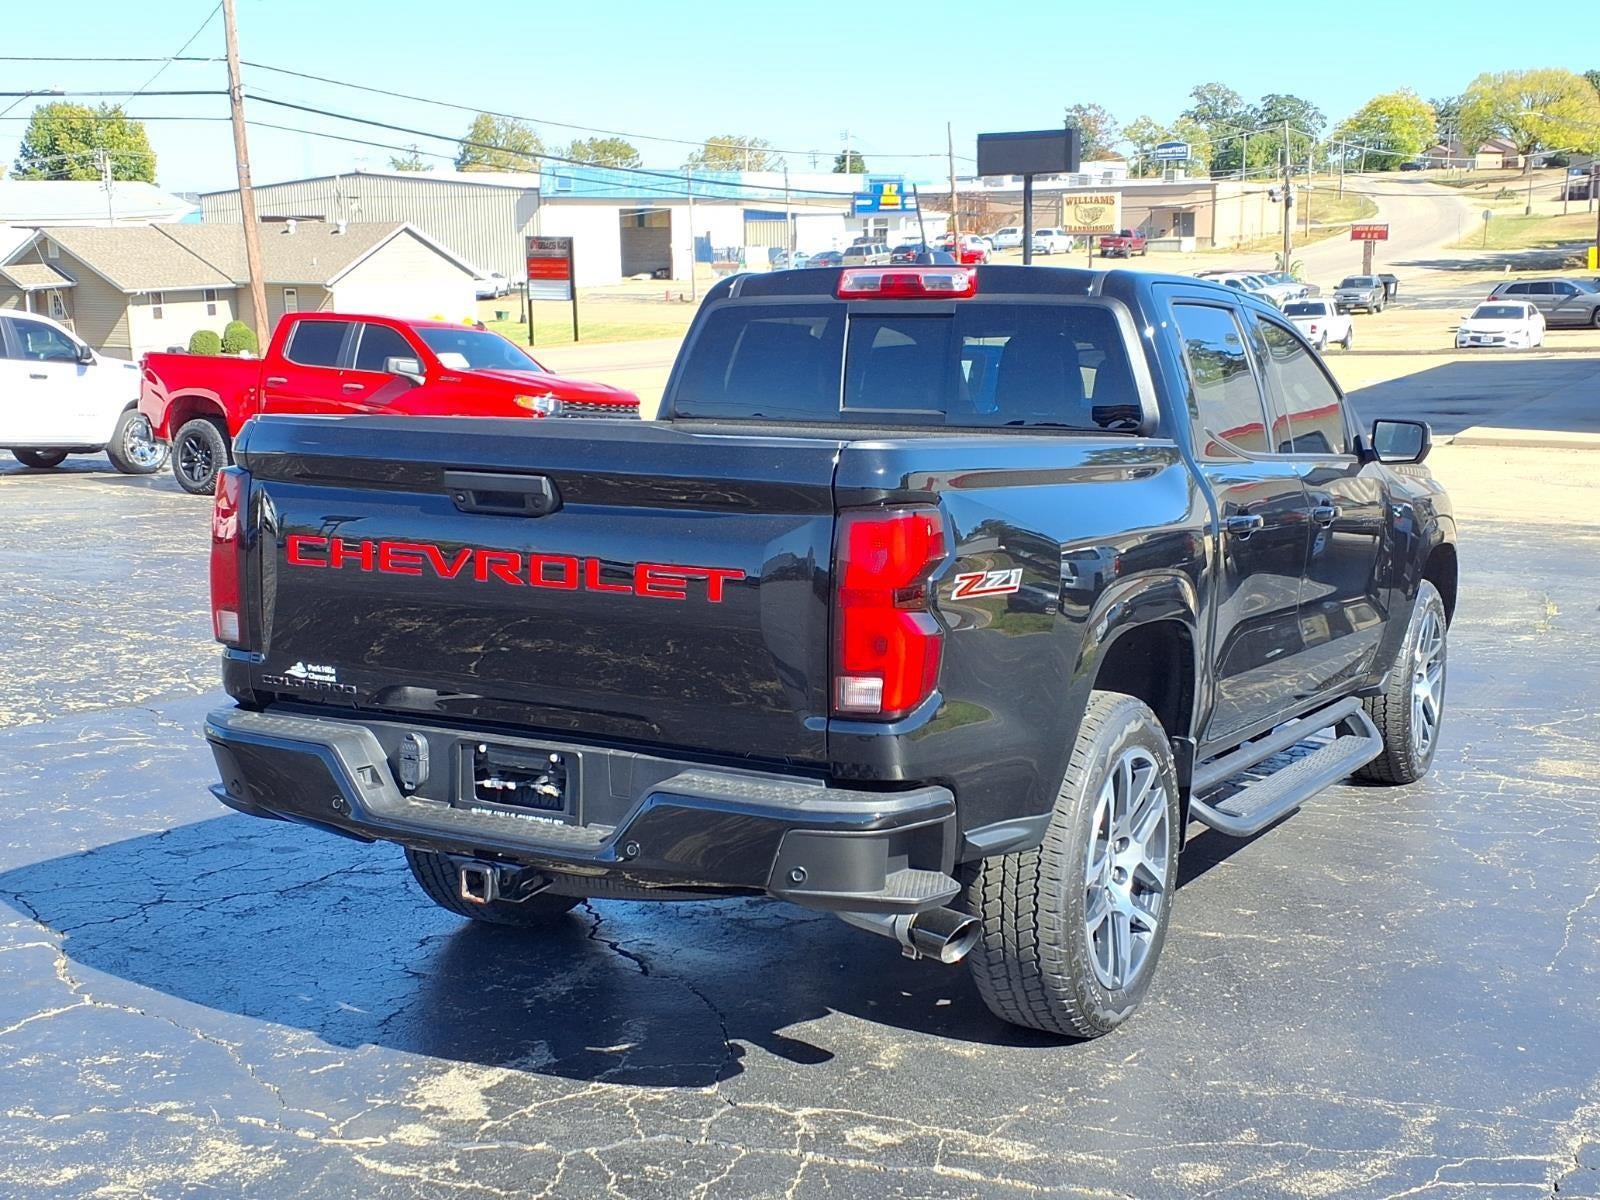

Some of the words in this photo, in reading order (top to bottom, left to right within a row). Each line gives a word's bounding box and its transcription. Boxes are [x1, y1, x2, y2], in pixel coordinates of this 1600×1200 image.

[1065, 195, 1115, 206] WILLIAMS
[286, 534, 747, 603] CHEVROLET
[951, 568, 1023, 601] Z71
[308, 664, 321, 672] Park
[321, 666, 336, 674] Hills
[263, 675, 357, 694] COLORADO
